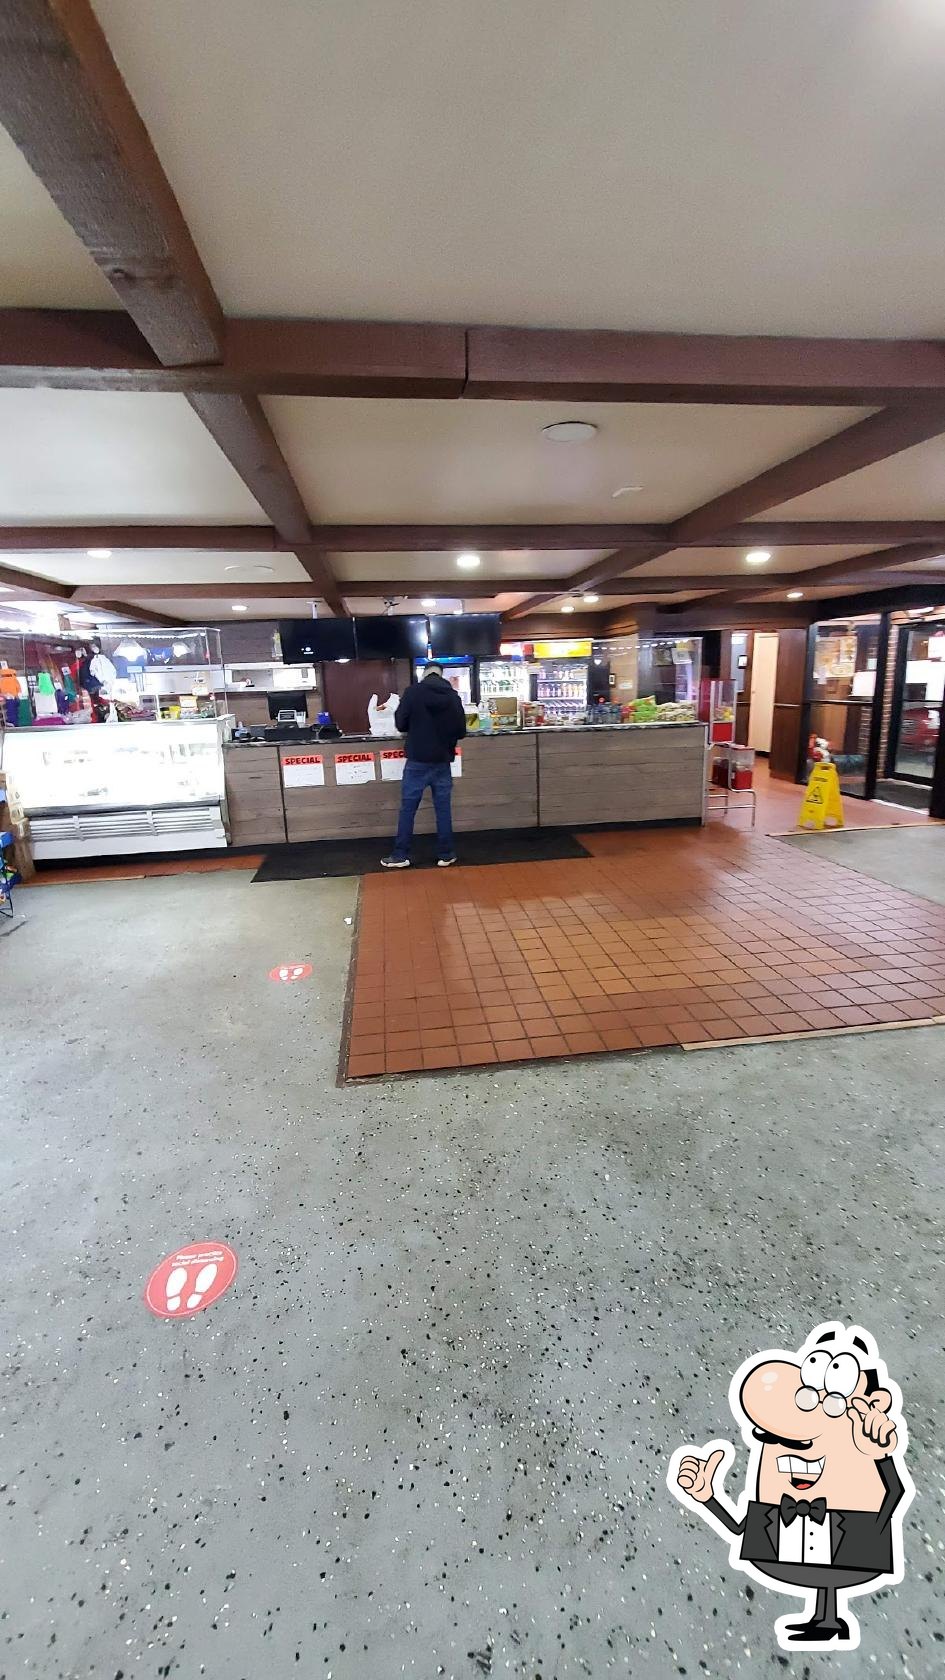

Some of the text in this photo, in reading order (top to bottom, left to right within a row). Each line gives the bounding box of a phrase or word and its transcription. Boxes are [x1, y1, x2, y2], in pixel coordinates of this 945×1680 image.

[337, 754, 372, 763] SPECIAL
[383, 751, 405, 759] SPEC
[285, 757, 321, 765] SPECIAL
